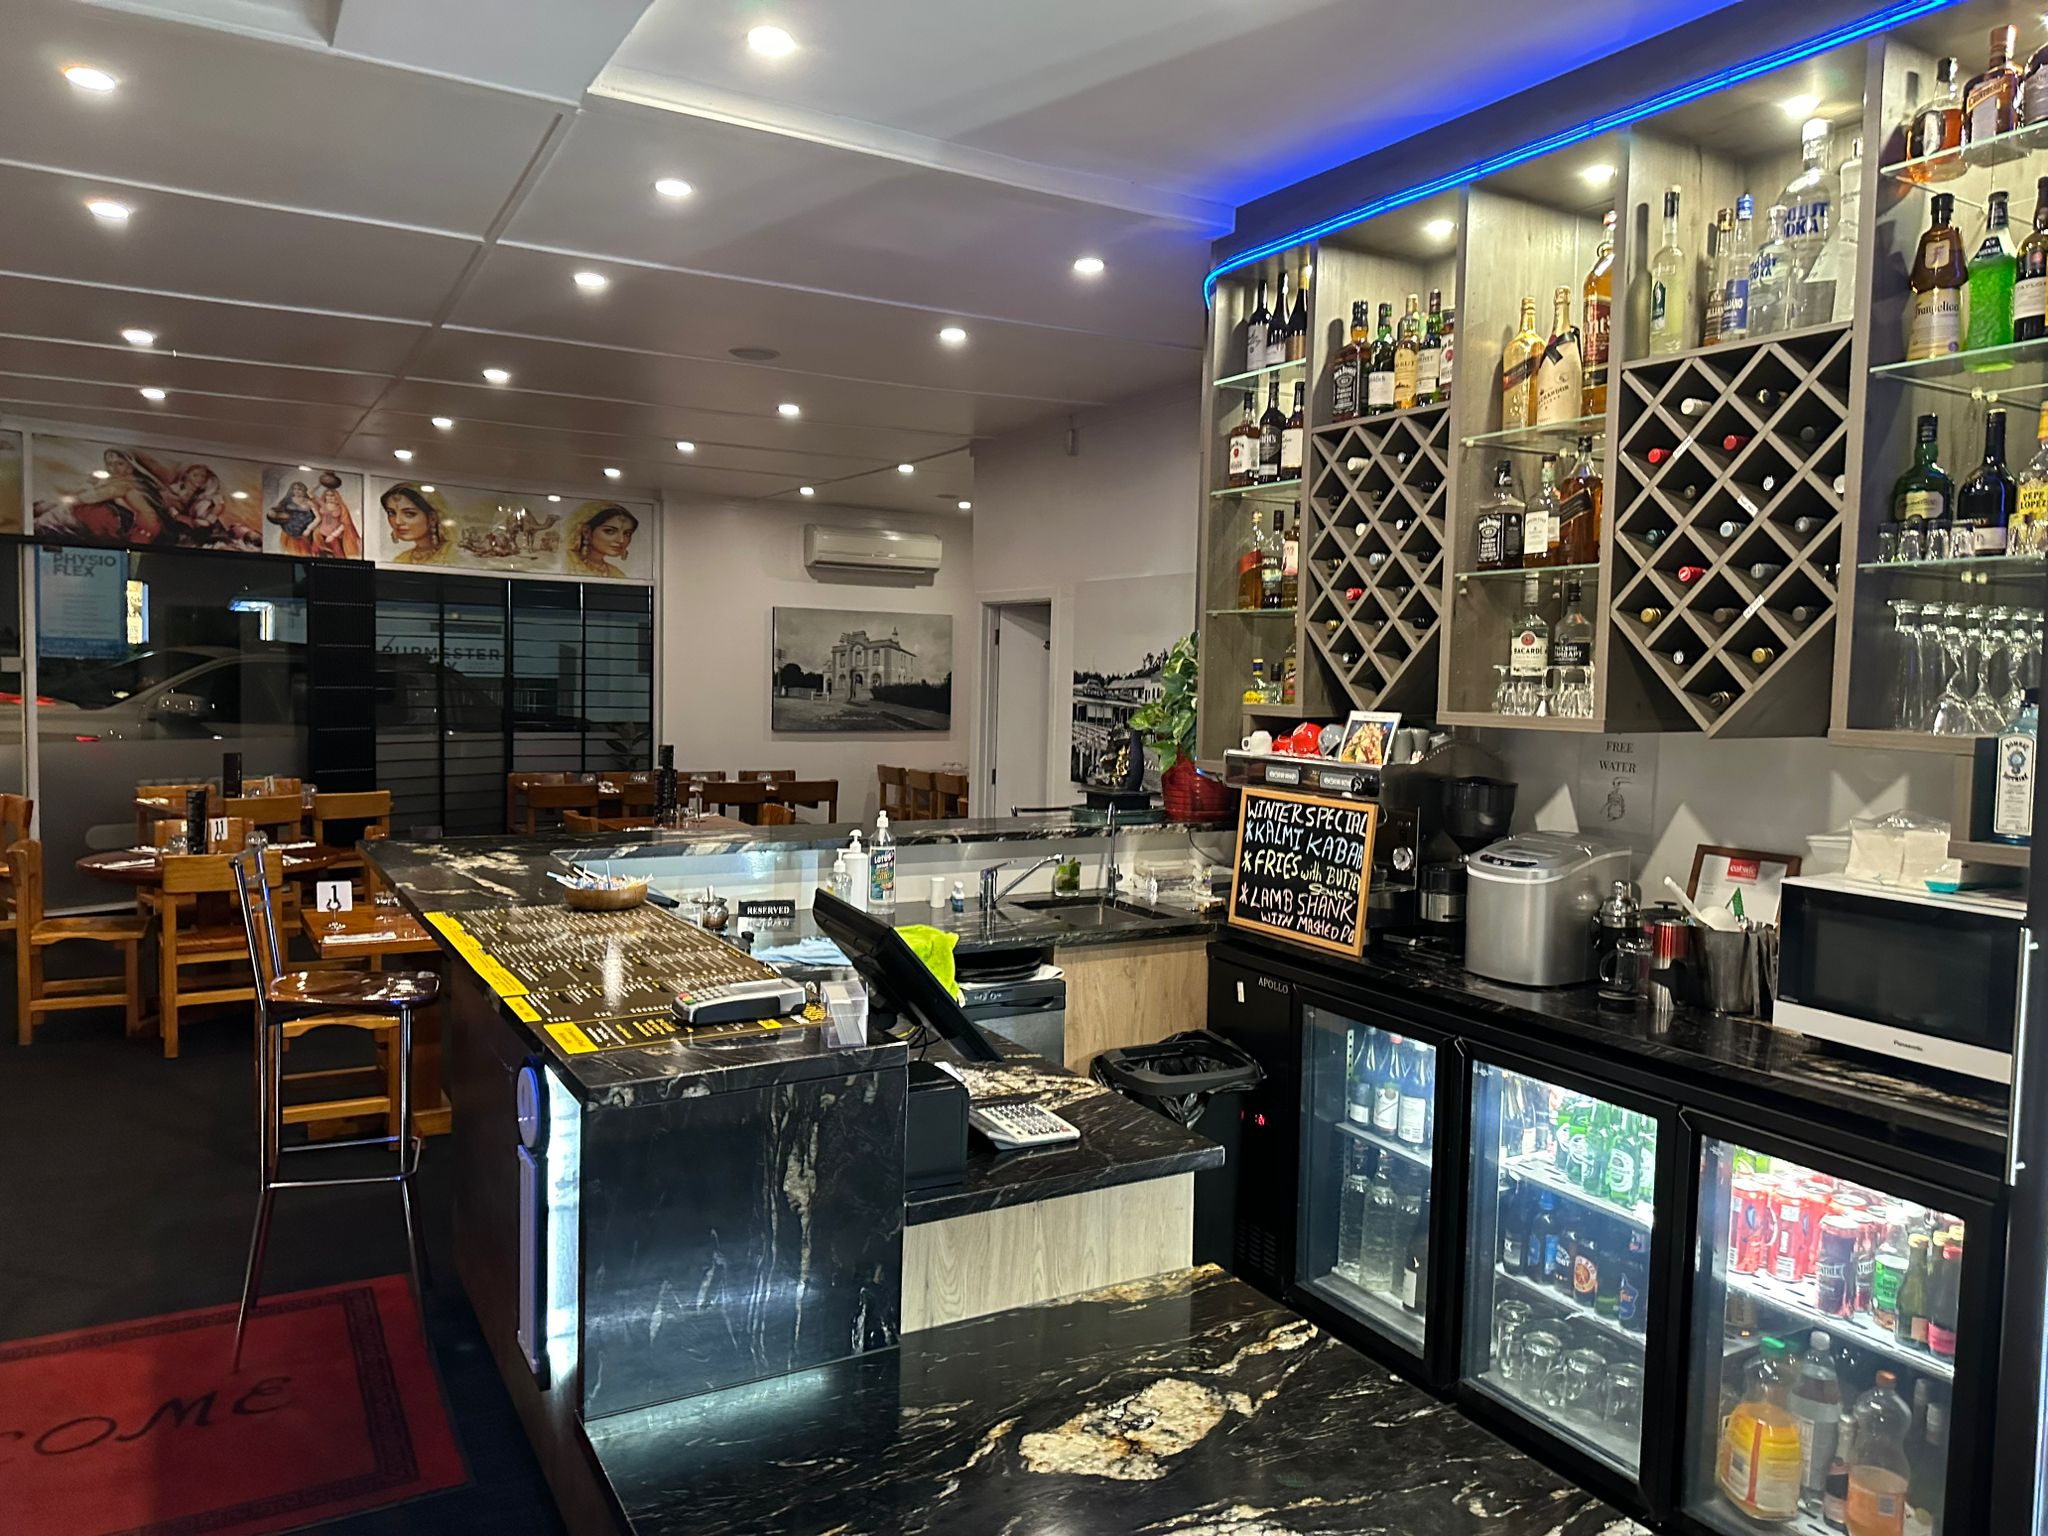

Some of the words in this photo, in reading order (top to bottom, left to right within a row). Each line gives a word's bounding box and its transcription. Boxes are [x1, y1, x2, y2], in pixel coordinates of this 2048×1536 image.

[53, 553, 117, 568] PHYSIO
[53, 564, 95, 577] FLEX
[1606, 741, 1634, 754] FREE
[1600, 760, 1637, 774] WATER
[1247, 799, 1304, 825] WINTER
[1305, 806, 1368, 837] SPECIAL
[747, 905, 790, 915] RESERVED
[1297, 893, 1356, 926] SHANK
[1258, 976, 1289, 994] APOLLO
[0, 1376, 293, 1466] OME
